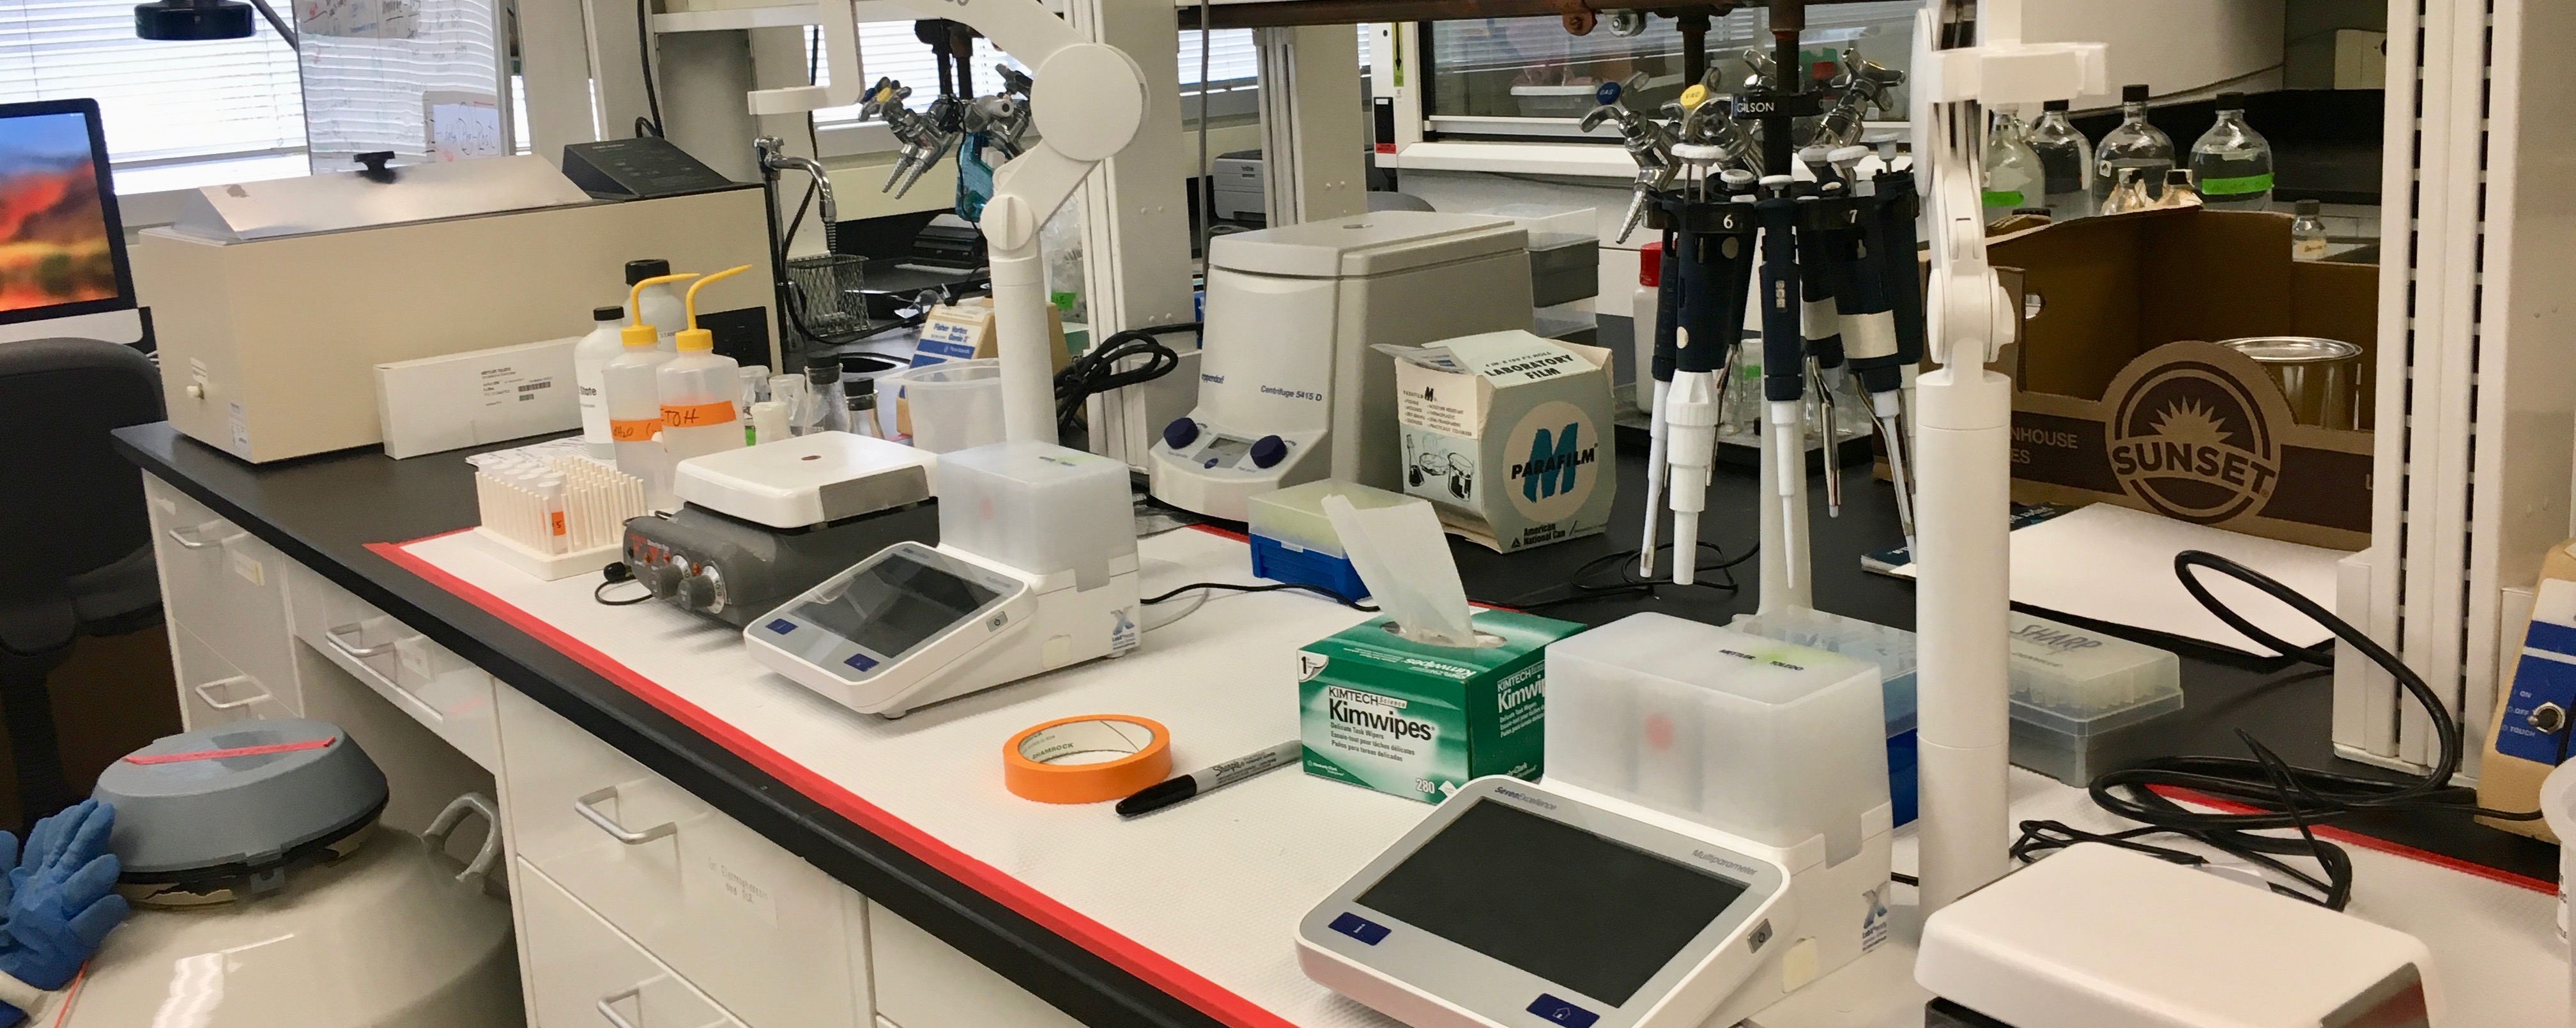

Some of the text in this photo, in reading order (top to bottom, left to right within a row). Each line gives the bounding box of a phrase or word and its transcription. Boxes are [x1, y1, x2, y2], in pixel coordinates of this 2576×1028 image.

[1685, 91, 1701, 100] VAC
[1736, 100, 1775, 113] GILSON
[1723, 214, 1733, 229] 6
[1849, 209, 1858, 224] 7
[1483, 354, 1574, 376] LABORATORY
[1524, 367, 1561, 380] FILM
[1261, 385, 1322, 402] Centrifuge 5415 D
[1511, 448, 1595, 480] PARAFILM
[2112, 441, 2276, 495] SUNSET
[2009, 624, 2103, 648] SHARP
[1301, 656, 1307, 675] 1
[1497, 670, 1532, 693] KIMTECH
[1329, 686, 1406, 708] KIMTECH Science
[2519, 691, 2532, 699] ON
[1330, 698, 1432, 740] Kimwipes
[2514, 707, 2530, 716] OFF
[2510, 725, 2536, 737] TOUCH
[1032, 742, 1074, 760] SHAMROCK
[1414, 777, 1436, 794] 280
[1494, 786, 1558, 810] SevenExcellence
[1691, 849, 1758, 875] Multiparameter
